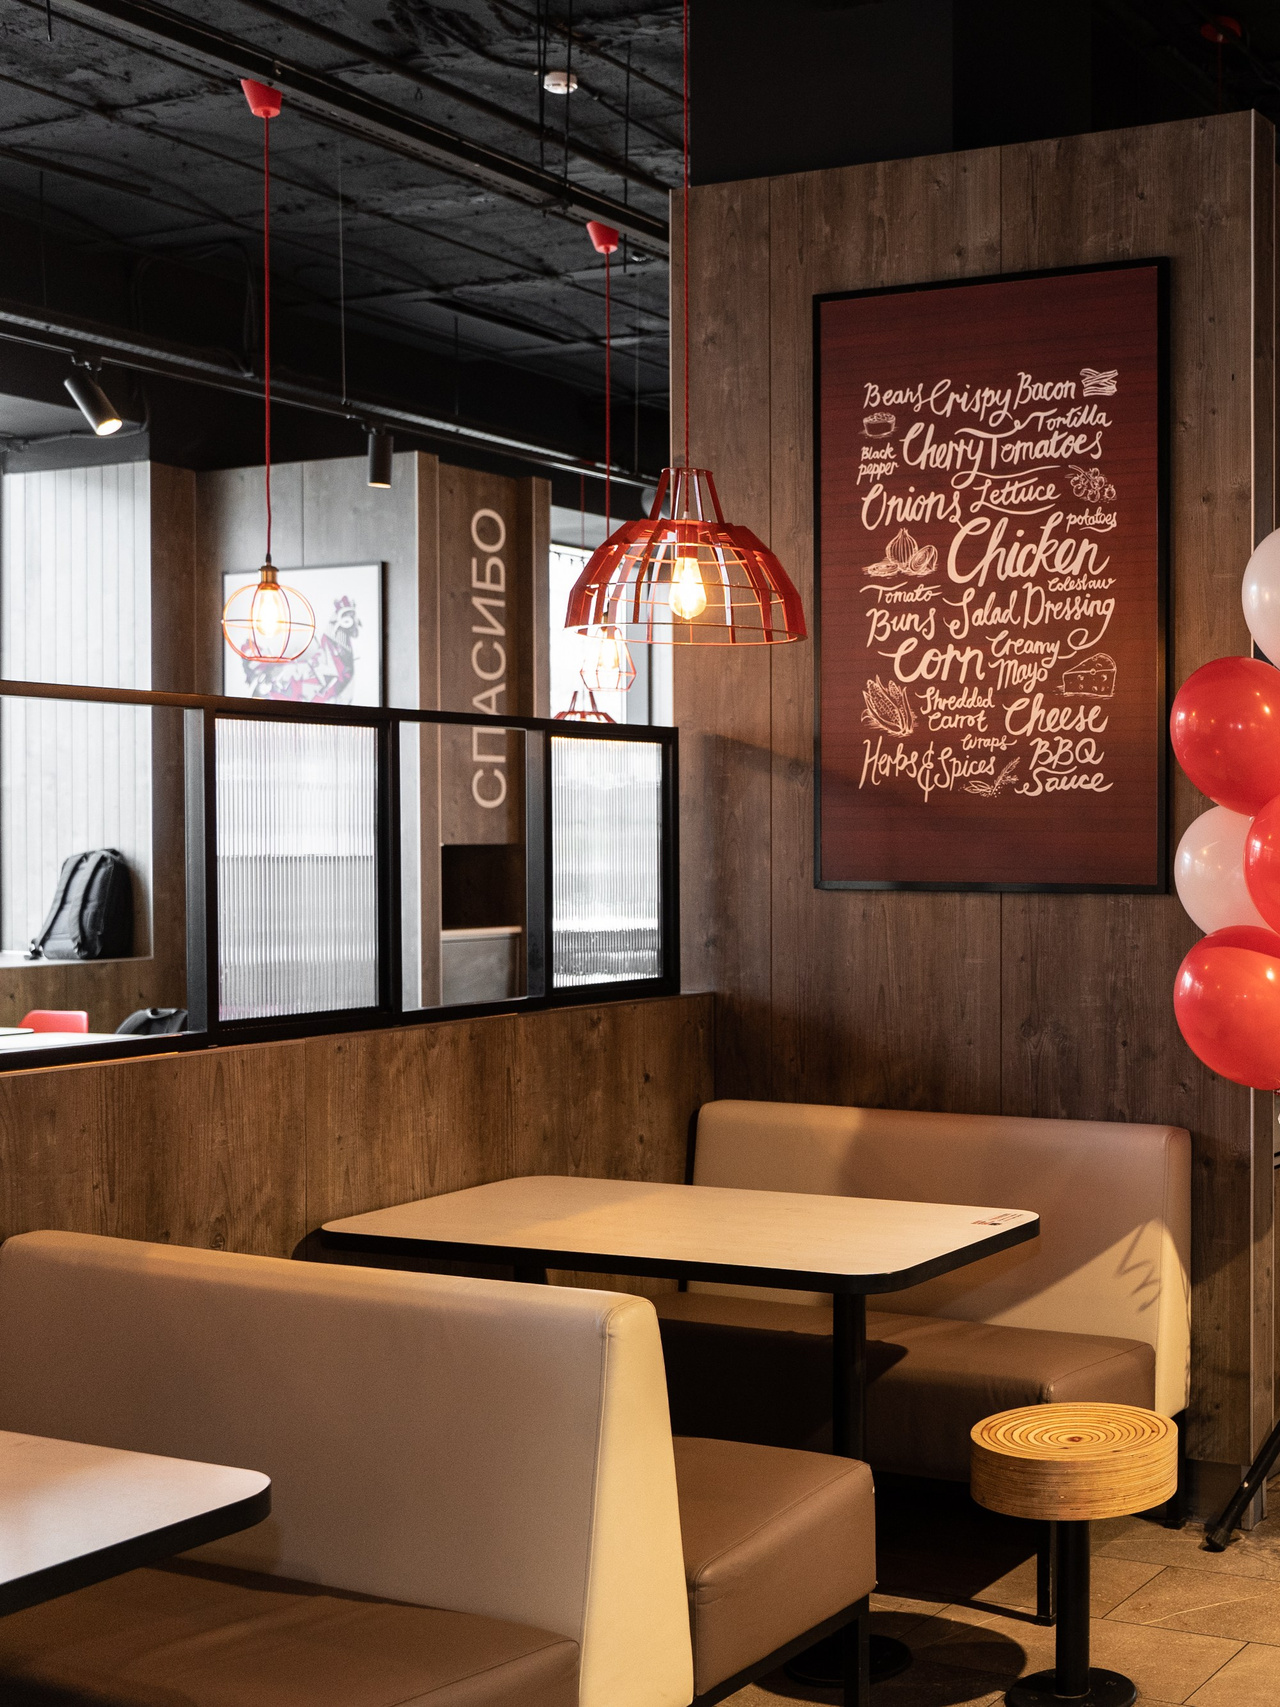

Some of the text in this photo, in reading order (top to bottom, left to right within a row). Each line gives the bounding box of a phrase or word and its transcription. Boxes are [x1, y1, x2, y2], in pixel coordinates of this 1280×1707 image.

[863, 371, 1076, 427] Beans Crispy Bacon
[1027, 404, 1113, 432] Tortilla
[861, 443, 897, 461] Black
[899, 422, 1103, 489] Cherry Tomatoes
[856, 461, 899, 485] pepper
[862, 484, 963, 530] Onions
[970, 477, 1062, 514] Lettuce
[1066, 508, 1117, 532] potatoes
[947, 511, 1110, 587] Chicken
[860, 581, 943, 604] Tomato
[866, 608, 937, 647] Buns
[942, 582, 1115, 649] Salad Dressing
[471, 508, 507, 808] СПАСИБО
[878, 638, 985, 683] Corn
[986, 630, 1061, 668] Creamy
[989, 659, 1048, 693] Mayo
[915, 687, 995, 714] Shredded
[1002, 693, 1109, 736] Cheese
[928, 710, 989, 732] Carrot
[858, 735, 918, 789] Herbs
[934, 747, 996, 791] Spices
[1029, 737, 1104, 770] BBQ
[1014, 766, 1113, 797] Sauce
